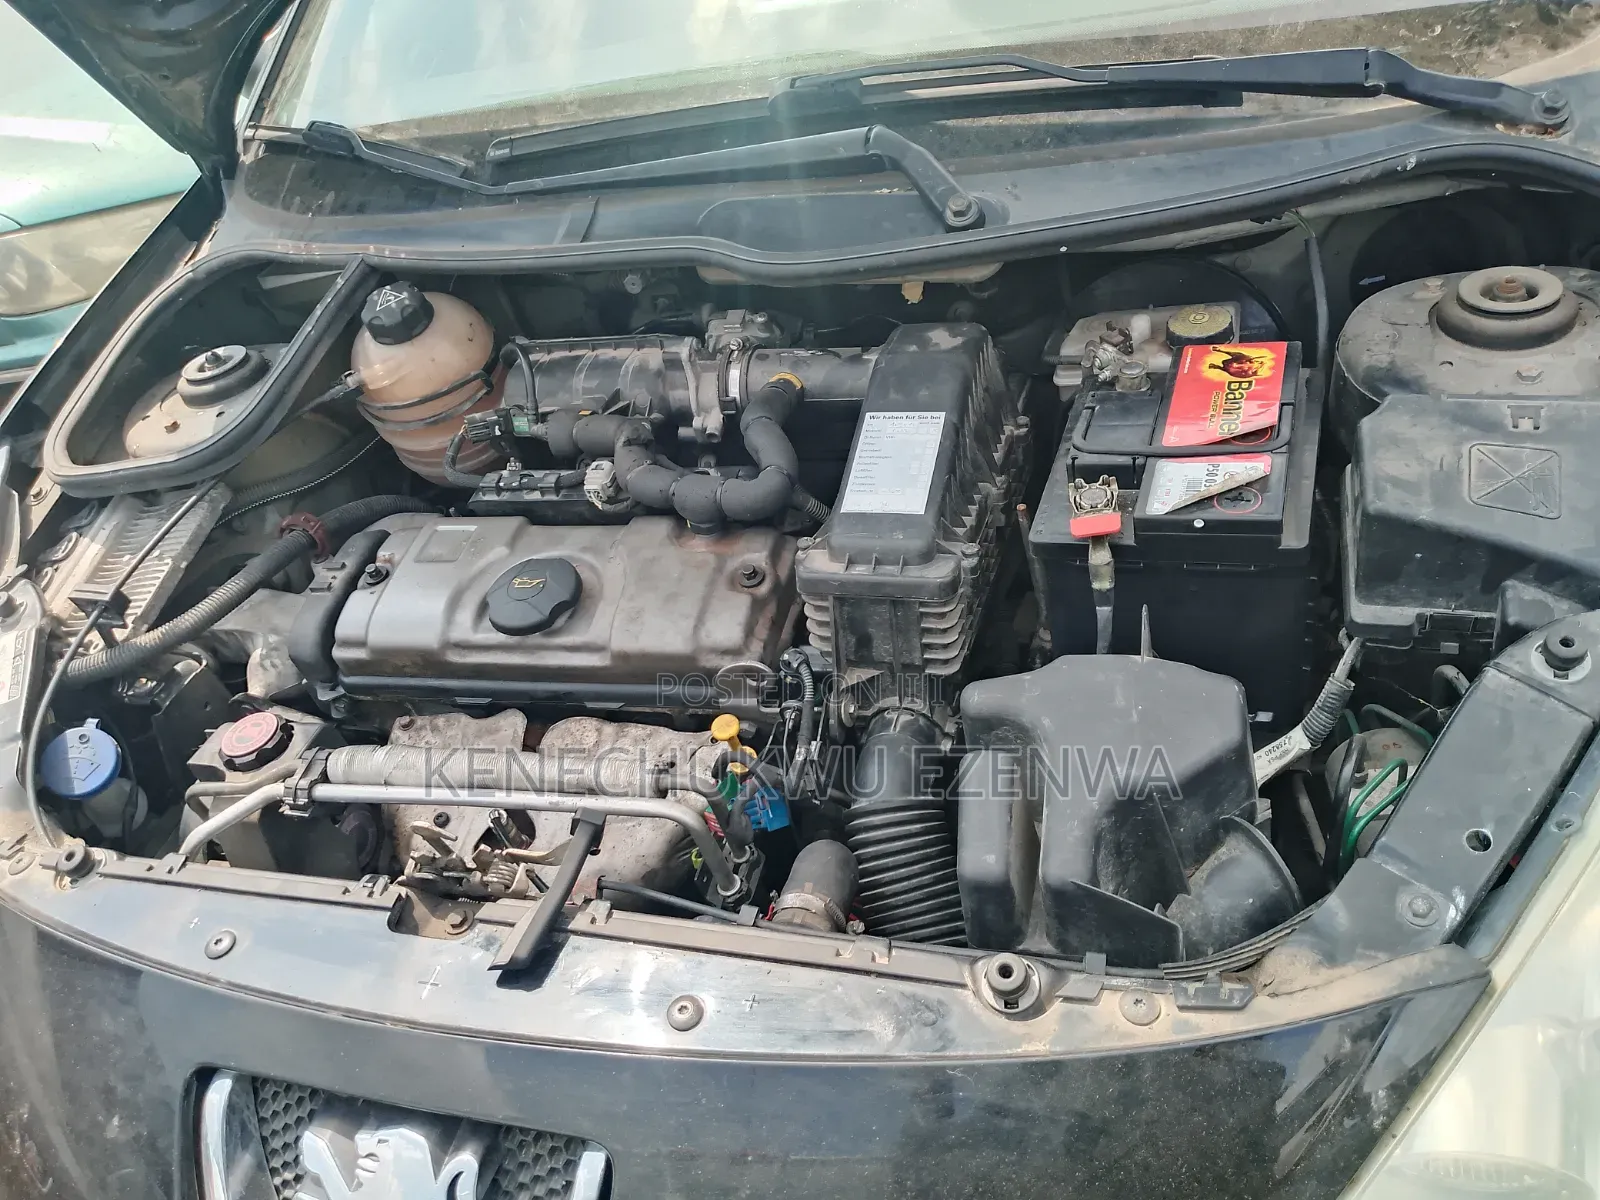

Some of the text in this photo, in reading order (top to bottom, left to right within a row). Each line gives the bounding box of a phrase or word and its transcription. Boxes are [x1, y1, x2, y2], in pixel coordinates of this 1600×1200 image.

[1207, 390, 1221, 429] POWER BULL
[1217, 379, 1255, 437] Banner
[1205, 463, 1221, 477] P50
